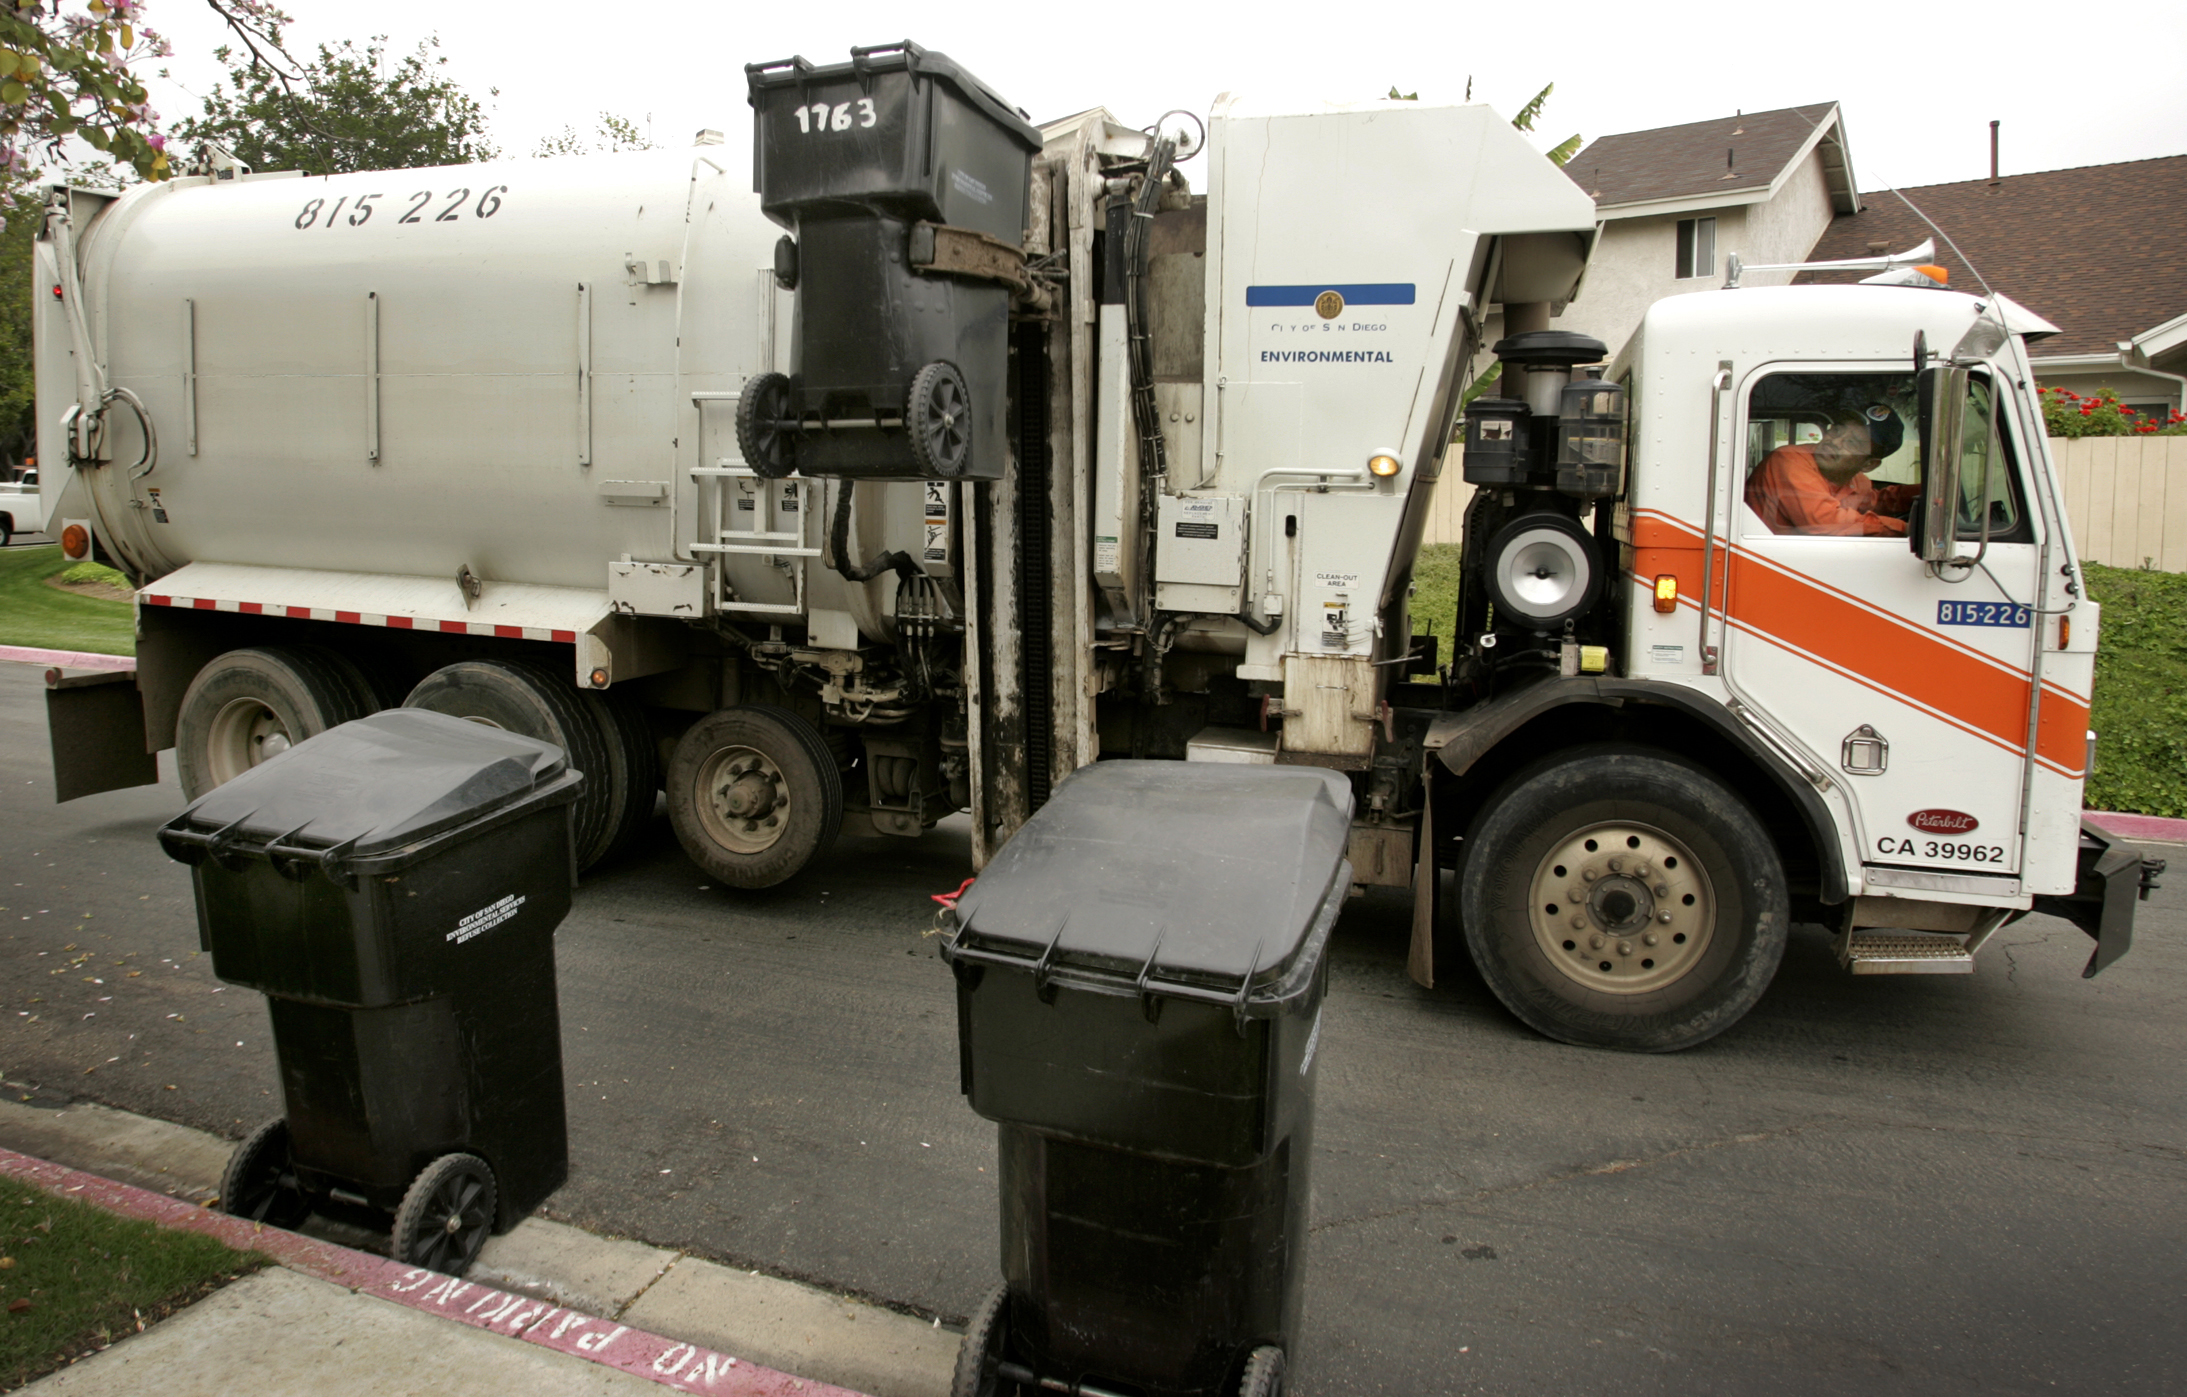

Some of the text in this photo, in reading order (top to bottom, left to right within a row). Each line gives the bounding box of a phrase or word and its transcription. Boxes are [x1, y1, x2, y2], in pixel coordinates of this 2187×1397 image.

[794, 98, 876, 133] 1763
[295, 185, 508, 230] 815 226
[1352, 323, 1387, 332] DIEGO
[1260, 351, 1393, 363] ENVIRONMENTAL
[1316, 573, 1358, 581] CLEAN-OUT
[1940, 603, 2027, 625] 815-226
[1915, 812, 1973, 829] Peterbilt
[1877, 837, 2004, 863] CA 39962
[446, 910, 499, 941] ENVIRONMENTAL
[457, 907, 518, 944] REFUSE COLLECTION
[459, 914, 475, 927] CITY
[475, 909, 484, 919] OF
[484, 903, 496, 914] SAN
[393, 1269, 736, 1383] NO PARKING
